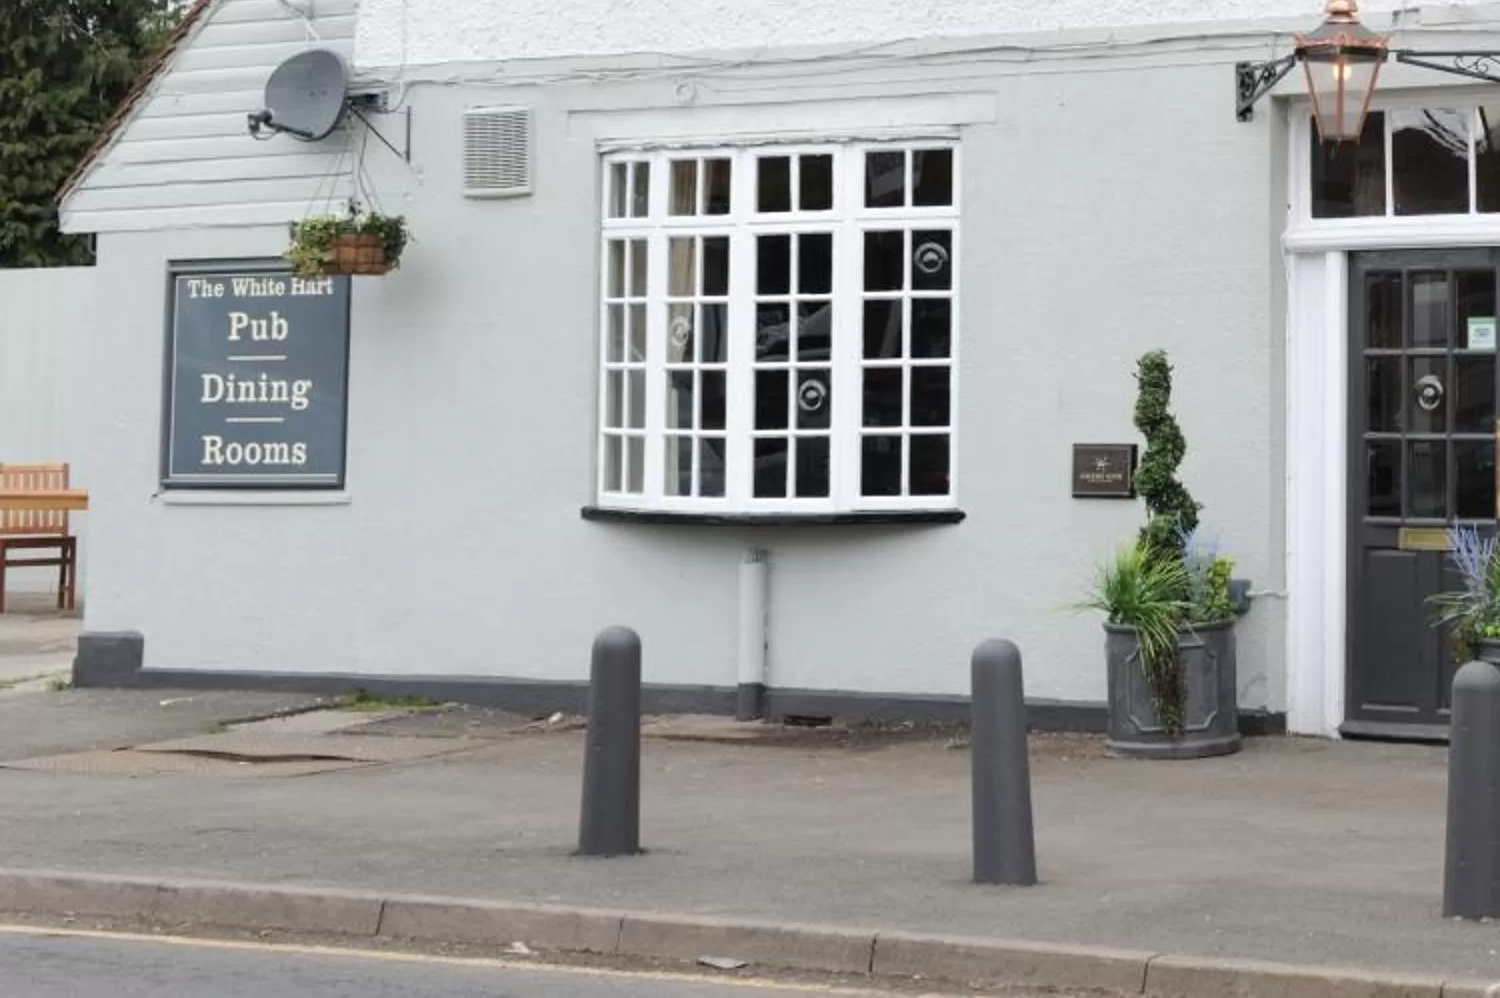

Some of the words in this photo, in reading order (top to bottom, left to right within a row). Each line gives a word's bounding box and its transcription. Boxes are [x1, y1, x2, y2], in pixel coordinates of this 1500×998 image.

[188, 279, 225, 298] The
[231, 277, 286, 297] White
[291, 276, 334, 295] Hart
[227, 311, 289, 341] Pub
[200, 372, 313, 410] Dining
[201, 435, 307, 465] Rooms
